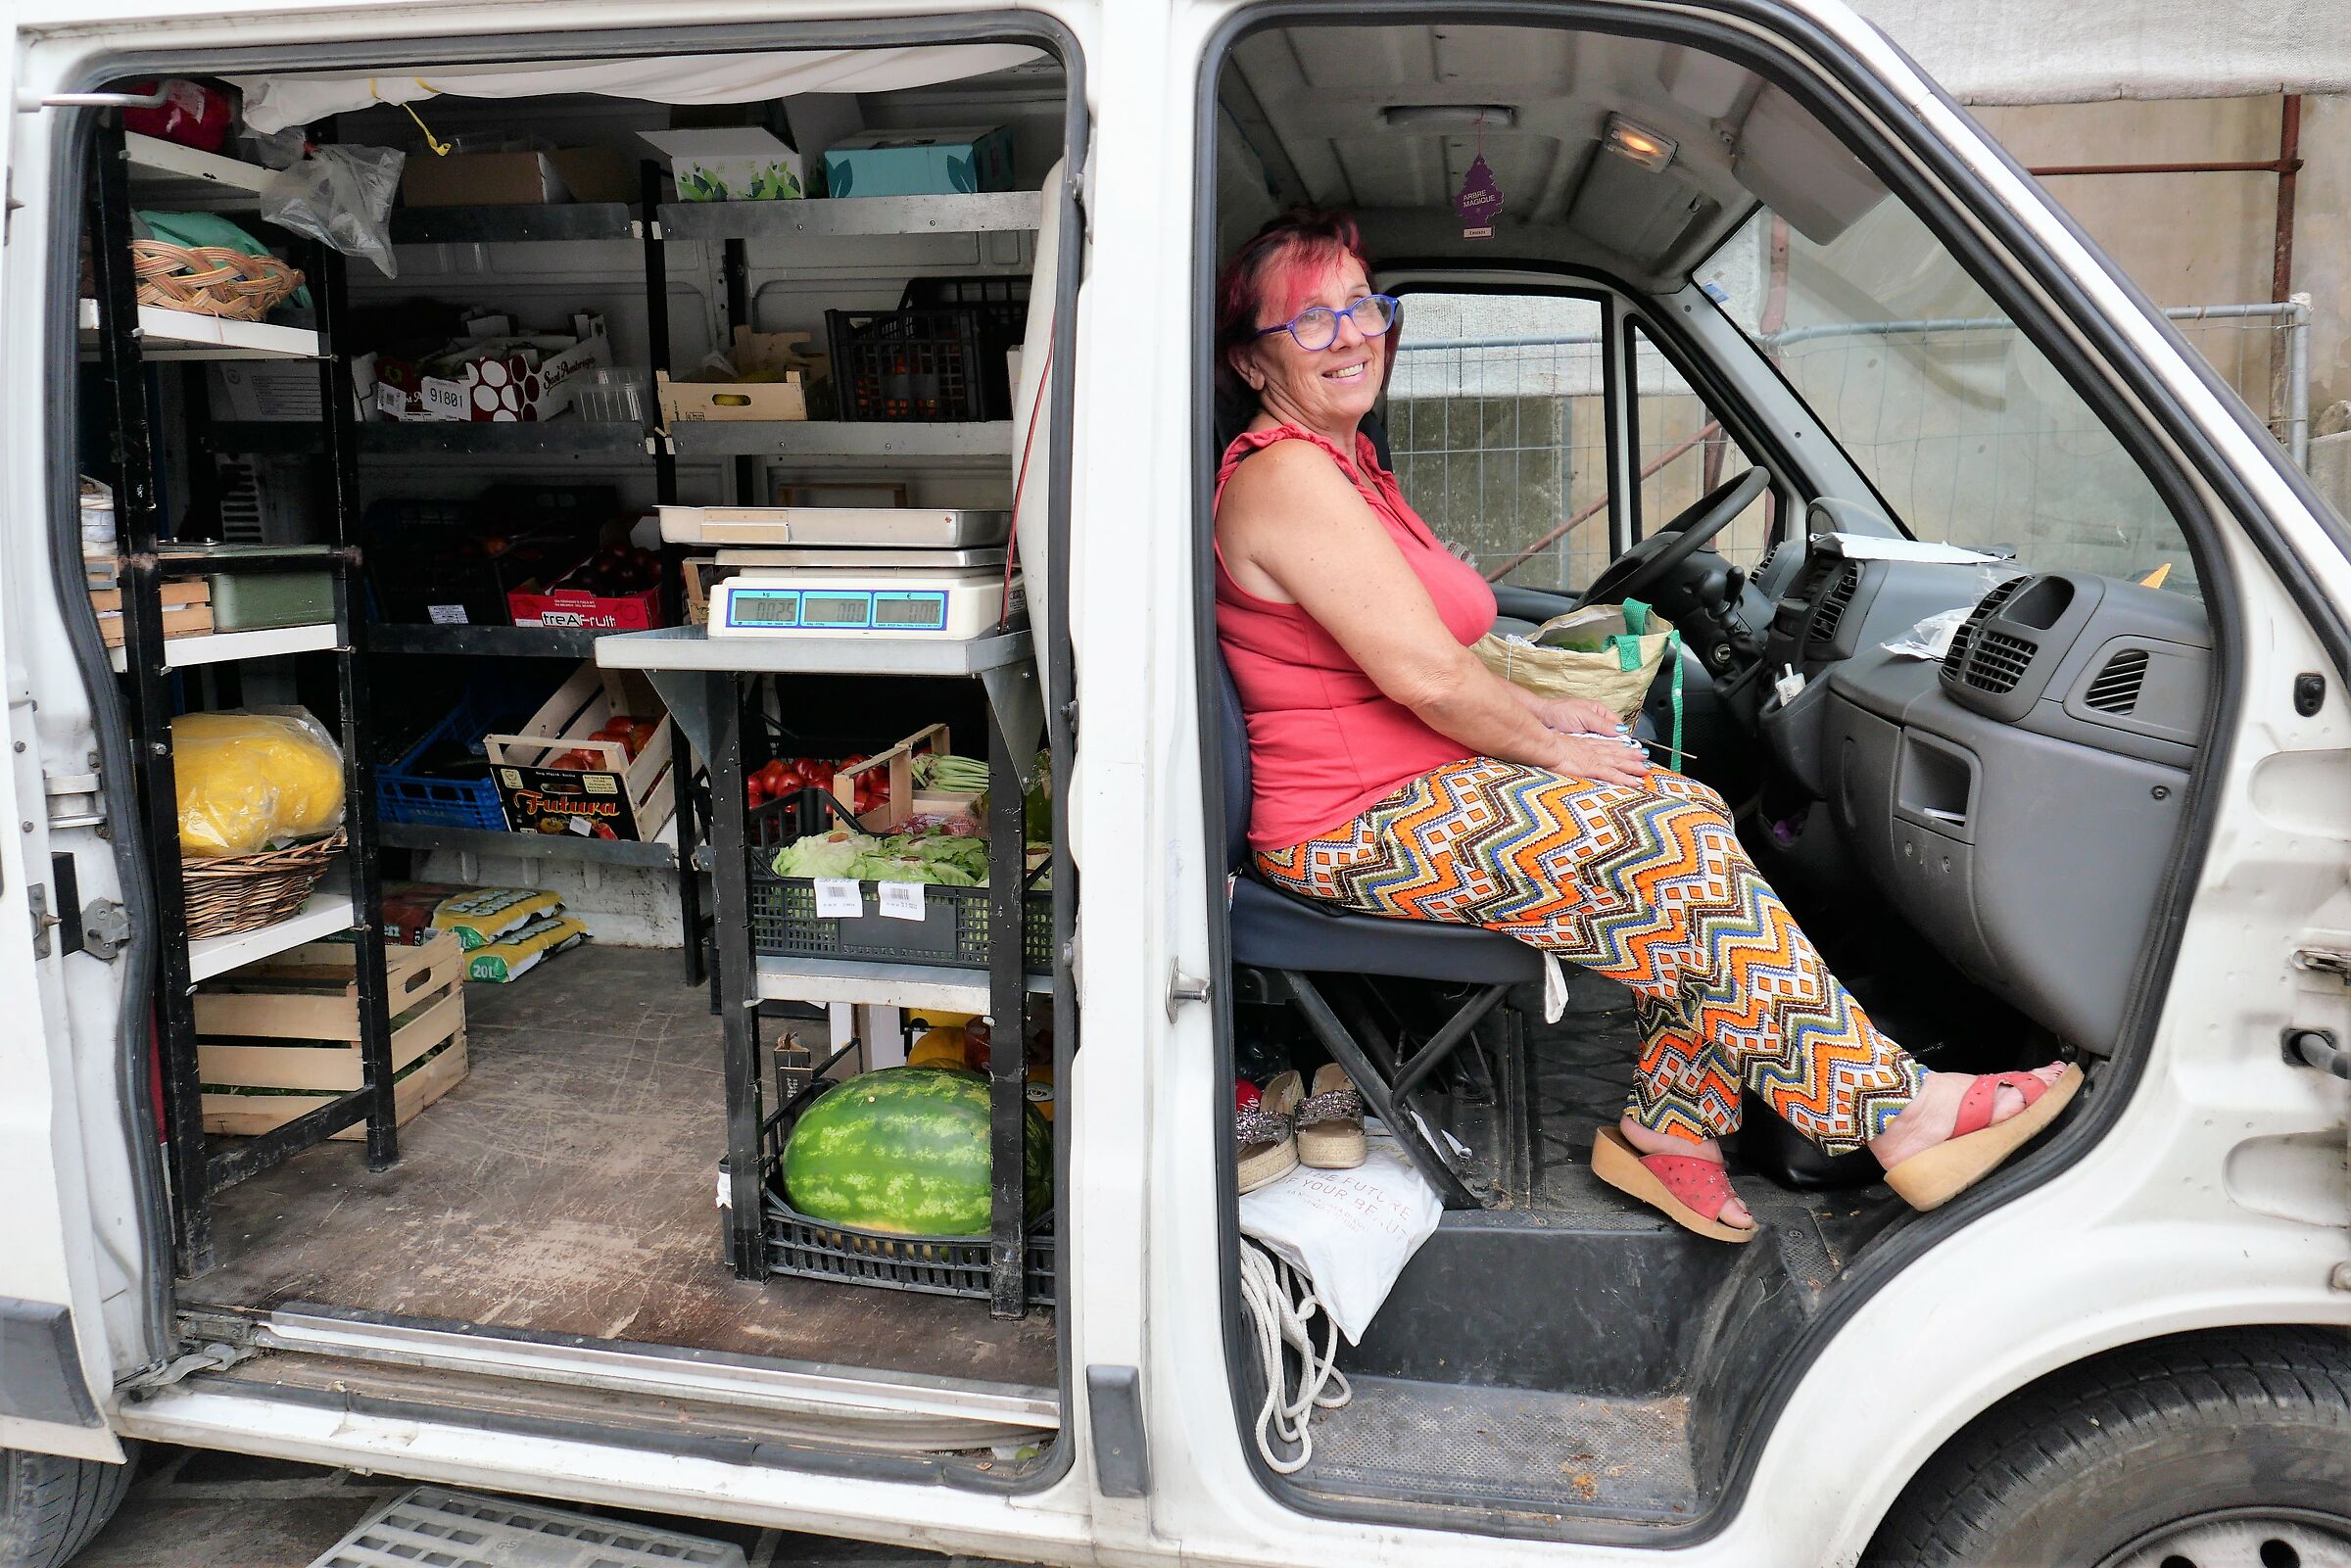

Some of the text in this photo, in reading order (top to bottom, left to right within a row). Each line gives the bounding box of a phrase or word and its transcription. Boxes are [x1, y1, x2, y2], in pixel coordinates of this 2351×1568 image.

[1463, 189, 1487, 201] ARBRE
[1463, 195, 1496, 207] MAGIQUE
[430, 388, 463, 408] 91801
[512, 789, 621, 816] Futura
[1302, 1179, 1348, 1200] YOUR
